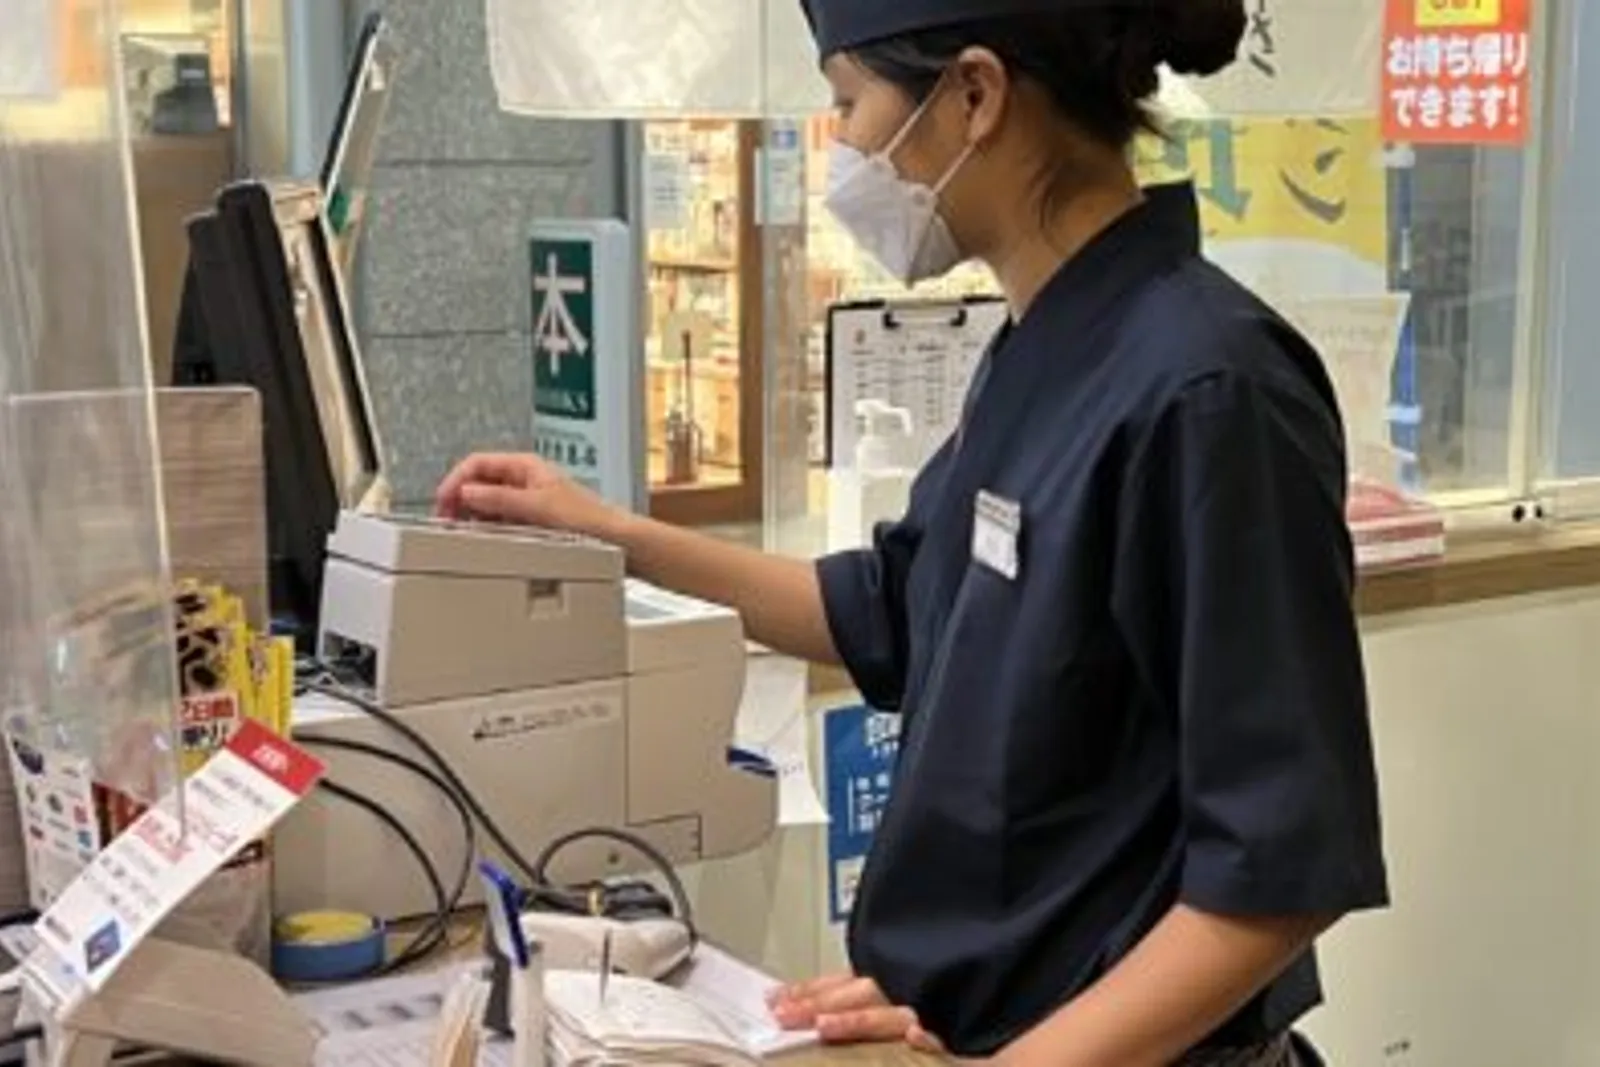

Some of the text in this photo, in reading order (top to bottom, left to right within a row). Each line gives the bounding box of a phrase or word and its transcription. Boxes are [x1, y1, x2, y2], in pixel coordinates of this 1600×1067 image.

[1388, 32, 1527, 78] お持ち帰り
[1390, 84, 1519, 130] できます!
[533, 252, 588, 376] 本
